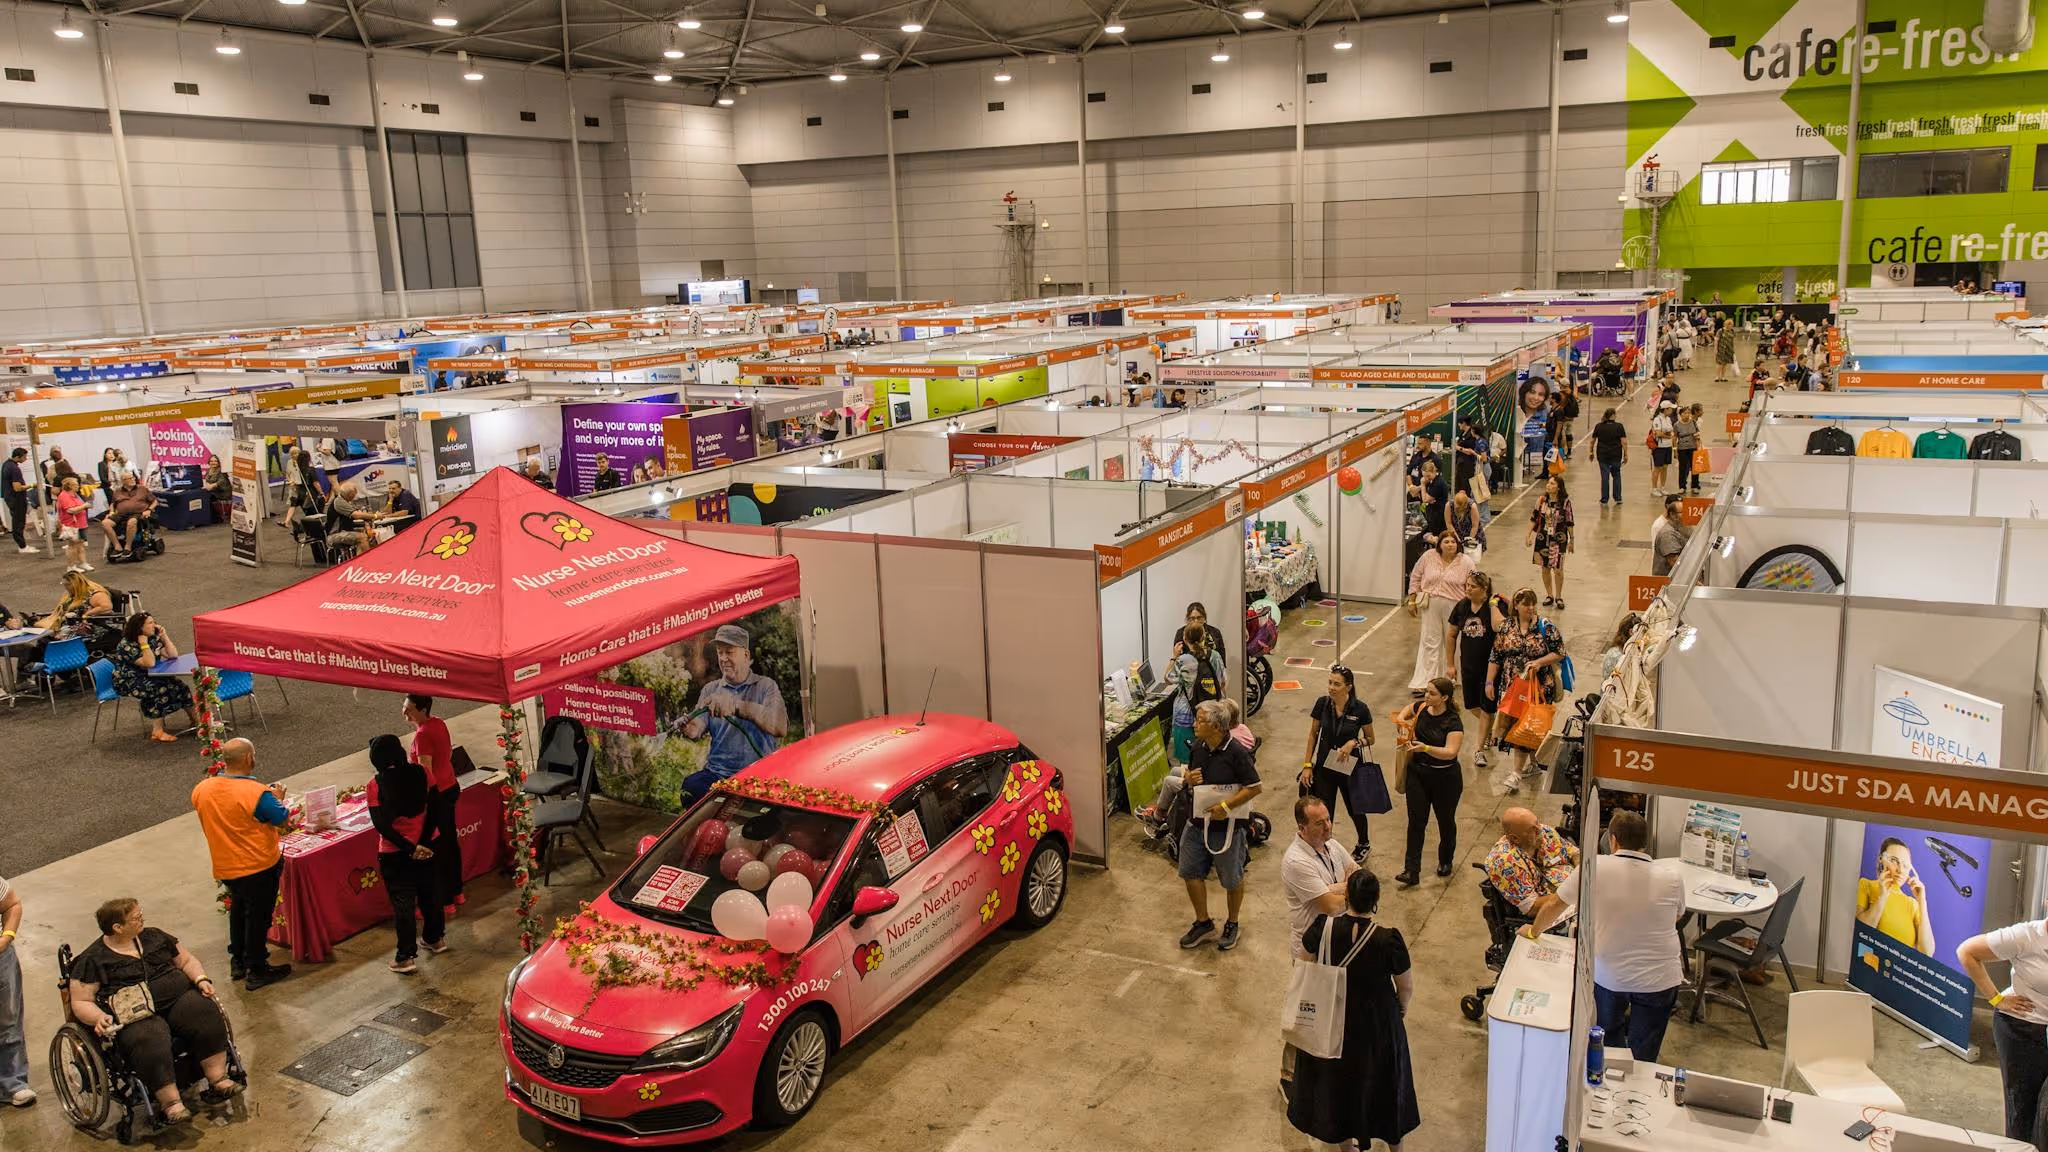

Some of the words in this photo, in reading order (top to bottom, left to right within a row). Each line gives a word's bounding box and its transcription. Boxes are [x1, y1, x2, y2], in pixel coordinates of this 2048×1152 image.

[1743, 28, 1837, 81] cafe
[1796, 124, 1825, 138] fresh
[1825, 122, 1848, 137] fres
[1857, 120, 1887, 134] fresh
[1918, 116, 1949, 130] fresh
[1983, 112, 2015, 126] fresh
[1868, 226, 1942, 264] cafe
[1757, 279, 1783, 294] cafe
[1383, 371, 1400, 379] CARE
[1401, 371, 1416, 379] AND
[1417, 371, 1450, 379] DISABILITY
[1846, 376, 1861, 384] 120
[1919, 376, 1931, 384] AT
[1932, 376, 1959, 385] HOME
[1963, 377, 1986, 385] CARE
[100, 415, 114, 423] APM
[114, 412, 153, 422] EMPLOYMENT
[154, 408, 182, 417] SERVICES
[573, 418, 603, 430] Define
[605, 420, 626, 432] your
[627, 422, 647, 432] own
[1730, 418, 1742, 428] 122
[150, 427, 194, 443] Looking
[575, 433, 592, 444] and
[594, 435, 619, 448] enjoy
[620, 437, 644, 447] more
[646, 436, 657, 447] of
[696, 434, 705, 445] My
[703, 433, 723, 443] space.
[151, 445, 168, 457] for
[169, 445, 204, 458] work?
[667, 444, 676, 454] My
[697, 444, 706, 455] My
[1247, 490, 1261, 500] 100
[1688, 506, 1703, 517] 124
[512, 565, 576, 592] Nurse
[571, 549, 623, 572] Next
[1099, 554, 1114, 567] PROD
[337, 565, 393, 585] Nurse
[391, 568, 442, 589] Next
[547, 579, 590, 600] home
[591, 570, 622, 585] care
[622, 556, 674, 576] services
[564, 566, 689, 608] nursenextdoor.com.au
[336, 586, 370, 599] home
[371, 589, 401, 601] care
[402, 593, 462, 610] services
[1636, 587, 1656, 600] 125
[319, 601, 447, 622] nursenextdoor.com.au
[559, 647, 597, 668] Home
[599, 636, 627, 656] Care
[627, 627, 651, 645] that
[652, 622, 662, 636] is
[663, 605, 709, 630] #Making
[709, 598, 735, 613] Lives
[734, 586, 764, 606] Better
[233, 642, 266, 658] Home
[267, 646, 292, 661] Care
[292, 649, 316, 664] that
[317, 651, 327, 665] is
[328, 652, 379, 675] #Making
[380, 659, 410, 676] Lives
[411, 662, 448, 680] Better
[565, 697, 591, 708] Home
[592, 702, 608, 712] care
[608, 704, 626, 714] that
[627, 706, 634, 716] is
[603, 688, 649, 704] possibility.
[560, 708, 591, 722] Making
[593, 712, 612, 724] Lives
[613, 715, 641, 729] Better.
[1901, 722, 1988, 766] UMBRELLA
[1612, 748, 1655, 772] 125
[1787, 769, 1849, 796] JUST
[1856, 777, 1915, 804] SDA
[1924, 786, 2048, 820] MANAG
[886, 912, 922, 944] Nurse
[923, 889, 951, 918] Next
[951, 871, 977, 898] Door
[889, 937, 912, 959] home
[913, 926, 930, 943] care
[931, 901, 961, 928] services
[1875, 939, 1889, 951] touch
[1889, 948, 1901, 958] with
[1907, 956, 1918, 967] and
[1918, 962, 1928, 972] get
[1927, 968, 1936, 976] up
[1935, 971, 1946, 981] and
[757, 997, 787, 1032] 1300
[785, 982, 809, 1002] 100
[810, 978, 831, 992] 247
[540, 1010, 562, 1029] Making
[562, 1022, 580, 1033] Lives
[579, 1026, 605, 1039] Better
